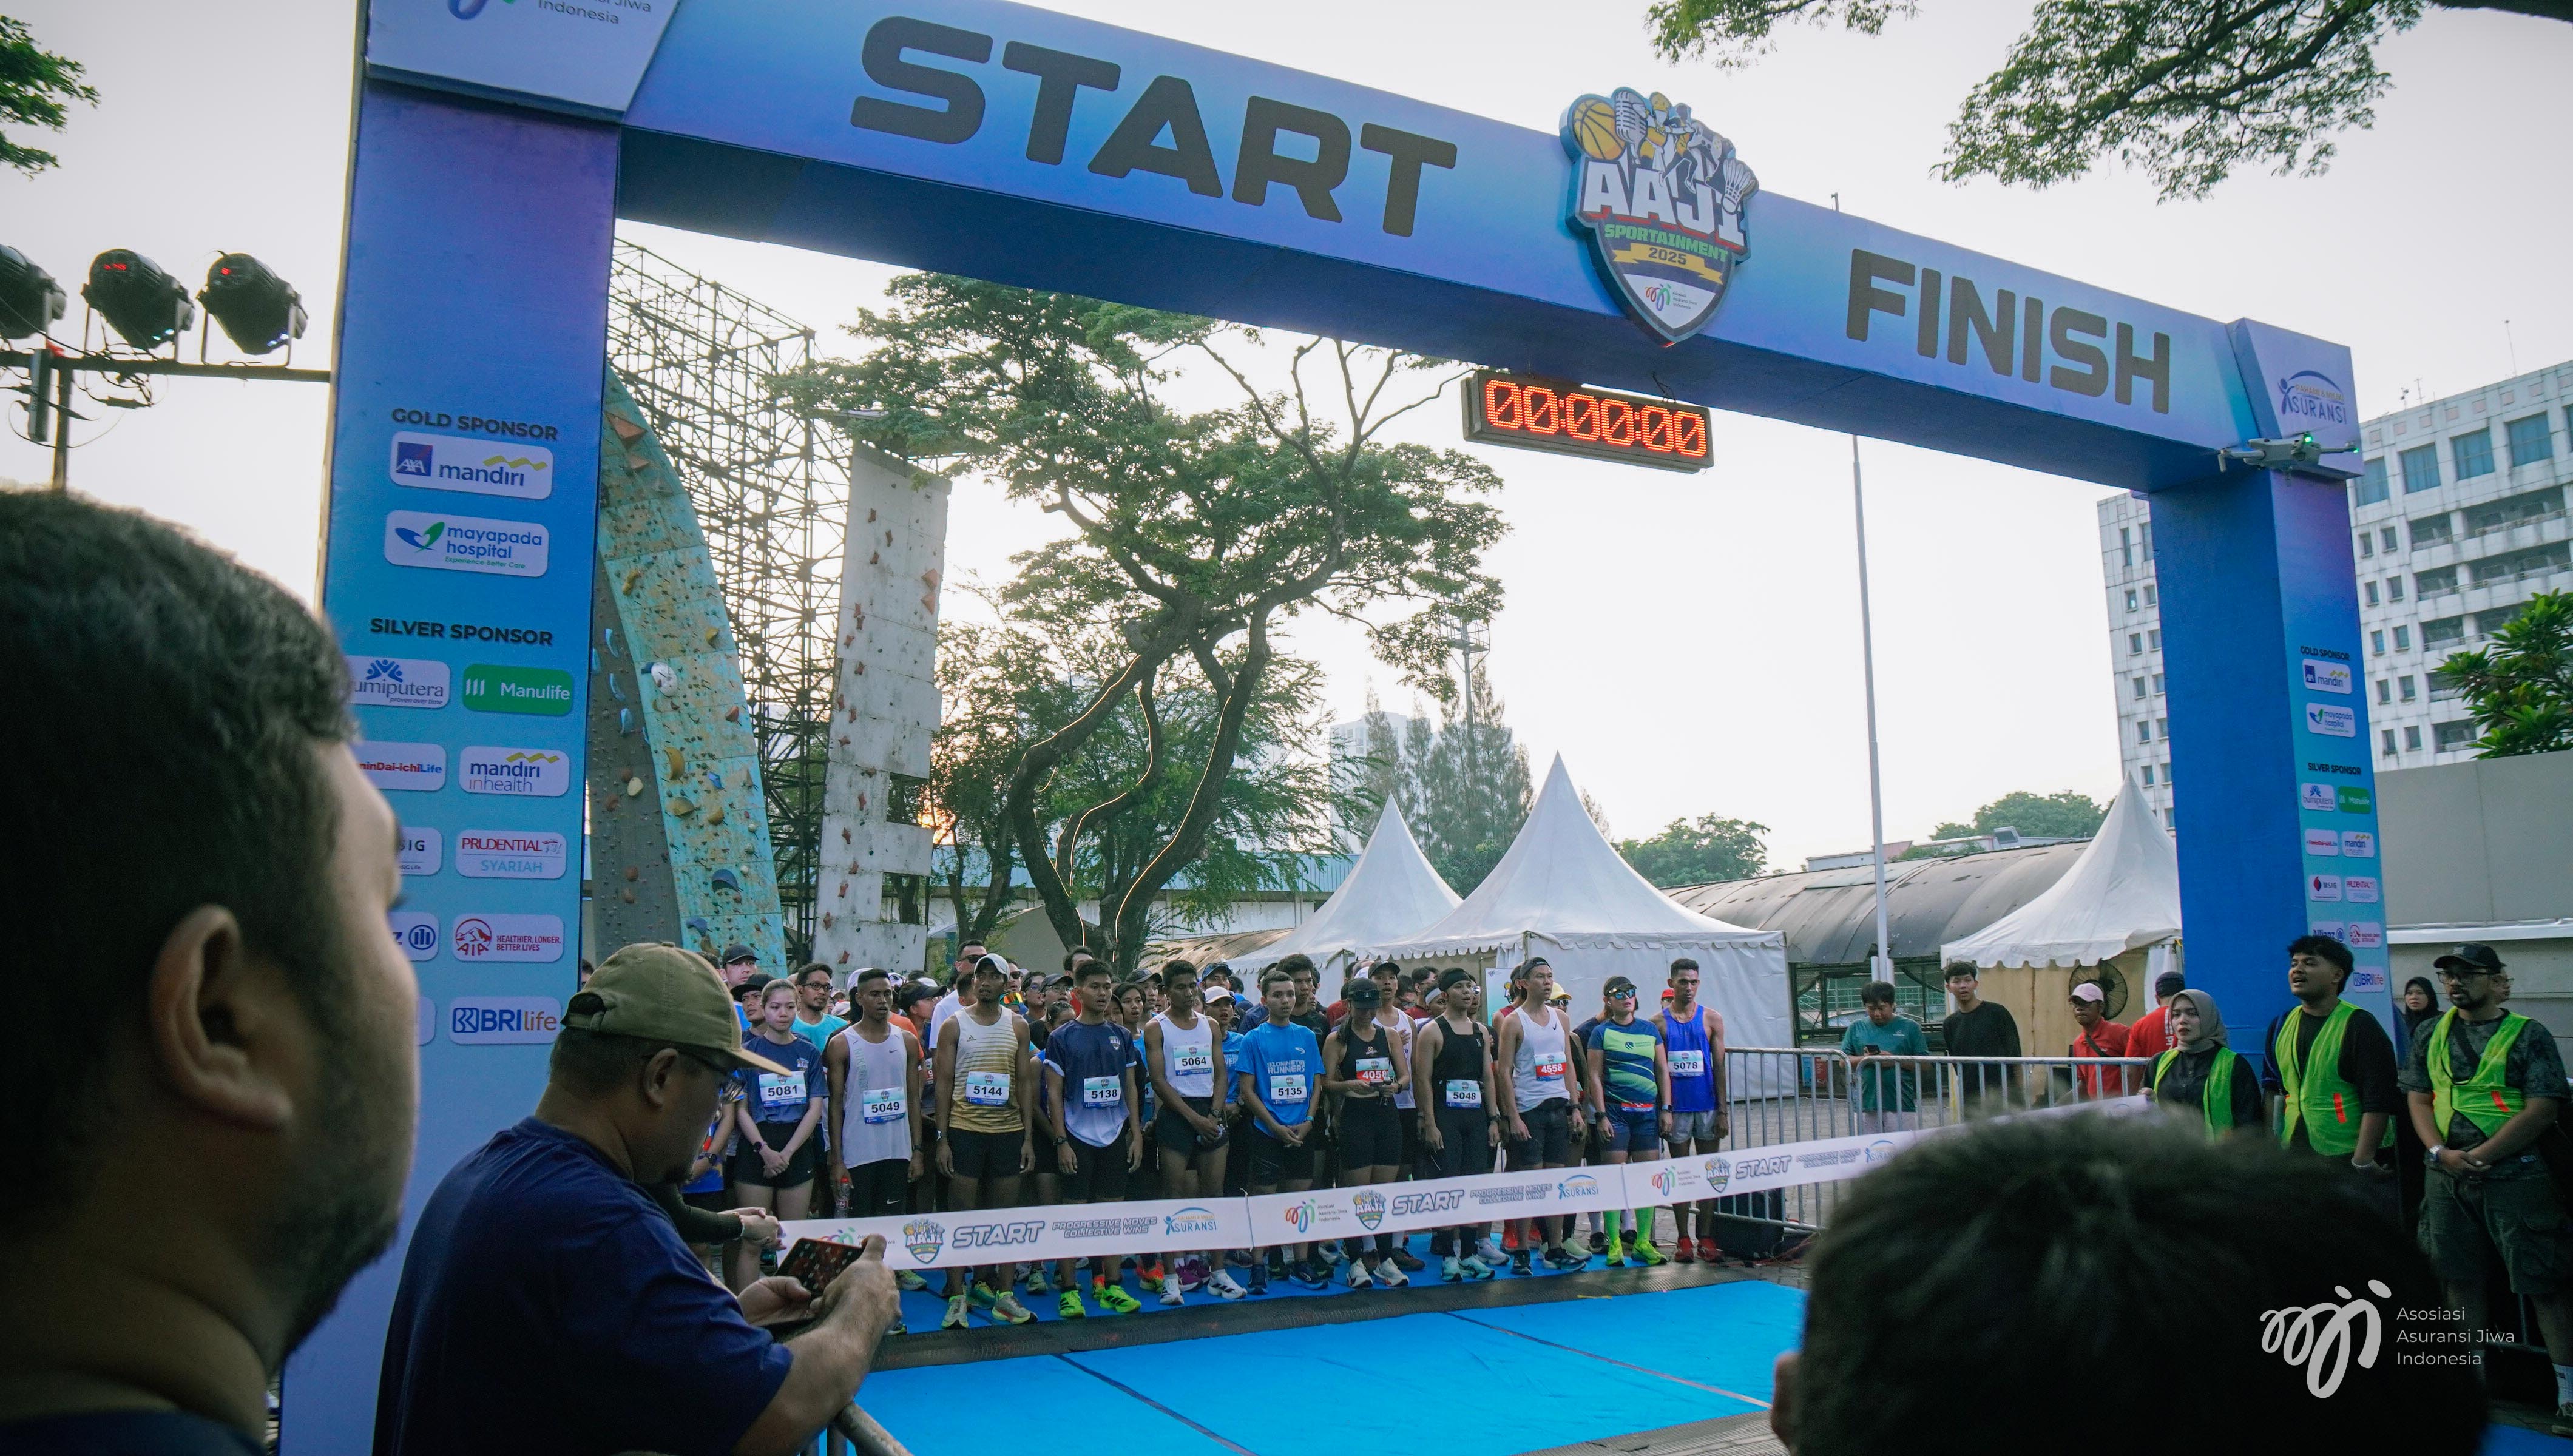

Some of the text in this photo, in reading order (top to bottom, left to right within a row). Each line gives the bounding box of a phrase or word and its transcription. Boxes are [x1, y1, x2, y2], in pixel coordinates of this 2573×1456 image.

[538, 0, 619, 24] Indonesia
[850, 16, 1457, 238] START
[1583, 159, 1745, 248] AAJI
[1604, 224, 1729, 263] SPORTAINMENT
[1649, 246, 1687, 265] 2025
[1846, 248, 2170, 415] FINISH
[2281, 394, 2347, 425] ASURANSI
[391, 408, 558, 440] GOLD SPONSOR
[1486, 380, 1706, 457] 00:00:00
[396, 459, 426, 473] AXA
[439, 463, 525, 486] mandiri
[447, 525, 543, 546] mayapada
[446, 540, 512, 559] hospital
[445, 556, 484, 566] Experience
[486, 558, 507, 568] Better
[370, 618, 553, 646] SILVER SPONSOR
[2300, 645, 2350, 661] GOLD SPONSOR
[354, 679, 444, 698] umiputera
[500, 681, 570, 701] Manulife
[359, 761, 442, 774] ninDai-ichiLife
[470, 761, 540, 778] mandiri
[2308, 763, 2362, 775] SILVER SPONSOR
[469, 777, 533, 792] inhealth
[399, 840, 425, 852] SIG
[462, 837, 543, 852] PRUDENTIAL
[481, 860, 543, 873] SYARIAH
[496, 935, 561, 945] HEALTHIER, LONGER,
[456, 944, 489, 956] AIA
[1182, 1057, 1206, 1067] 5064
[1267, 1065, 1305, 1074] RUNNERS
[1541, 1063, 1563, 1074] 4558
[768, 1085, 797, 1097] 5081
[973, 1085, 1002, 1096] 5144
[1091, 1089, 1117, 1099] 5138
[1278, 1087, 1302, 1096] 5135
[1453, 1092, 1476, 1100] 5048
[871, 1101, 899, 1113] 5049
[1736, 1155, 1791, 1180] START
[1470, 1183, 1553, 1198] PROGRESSIVE MOVES
[1479, 1191, 1546, 1205] COLLECTIVE WINS
[1558, 1185, 1599, 1200] ASURANSI
[1391, 1189, 1464, 1216] START
[1052, 1216, 1158, 1230] PROGRESSIVE MOVES
[1164, 1220, 1217, 1236] ASURANSI
[907, 1233, 942, 1244] AAJI
[952, 1221, 1045, 1249] START
[1064, 1225, 1149, 1238] COLLECTIVE WINS
